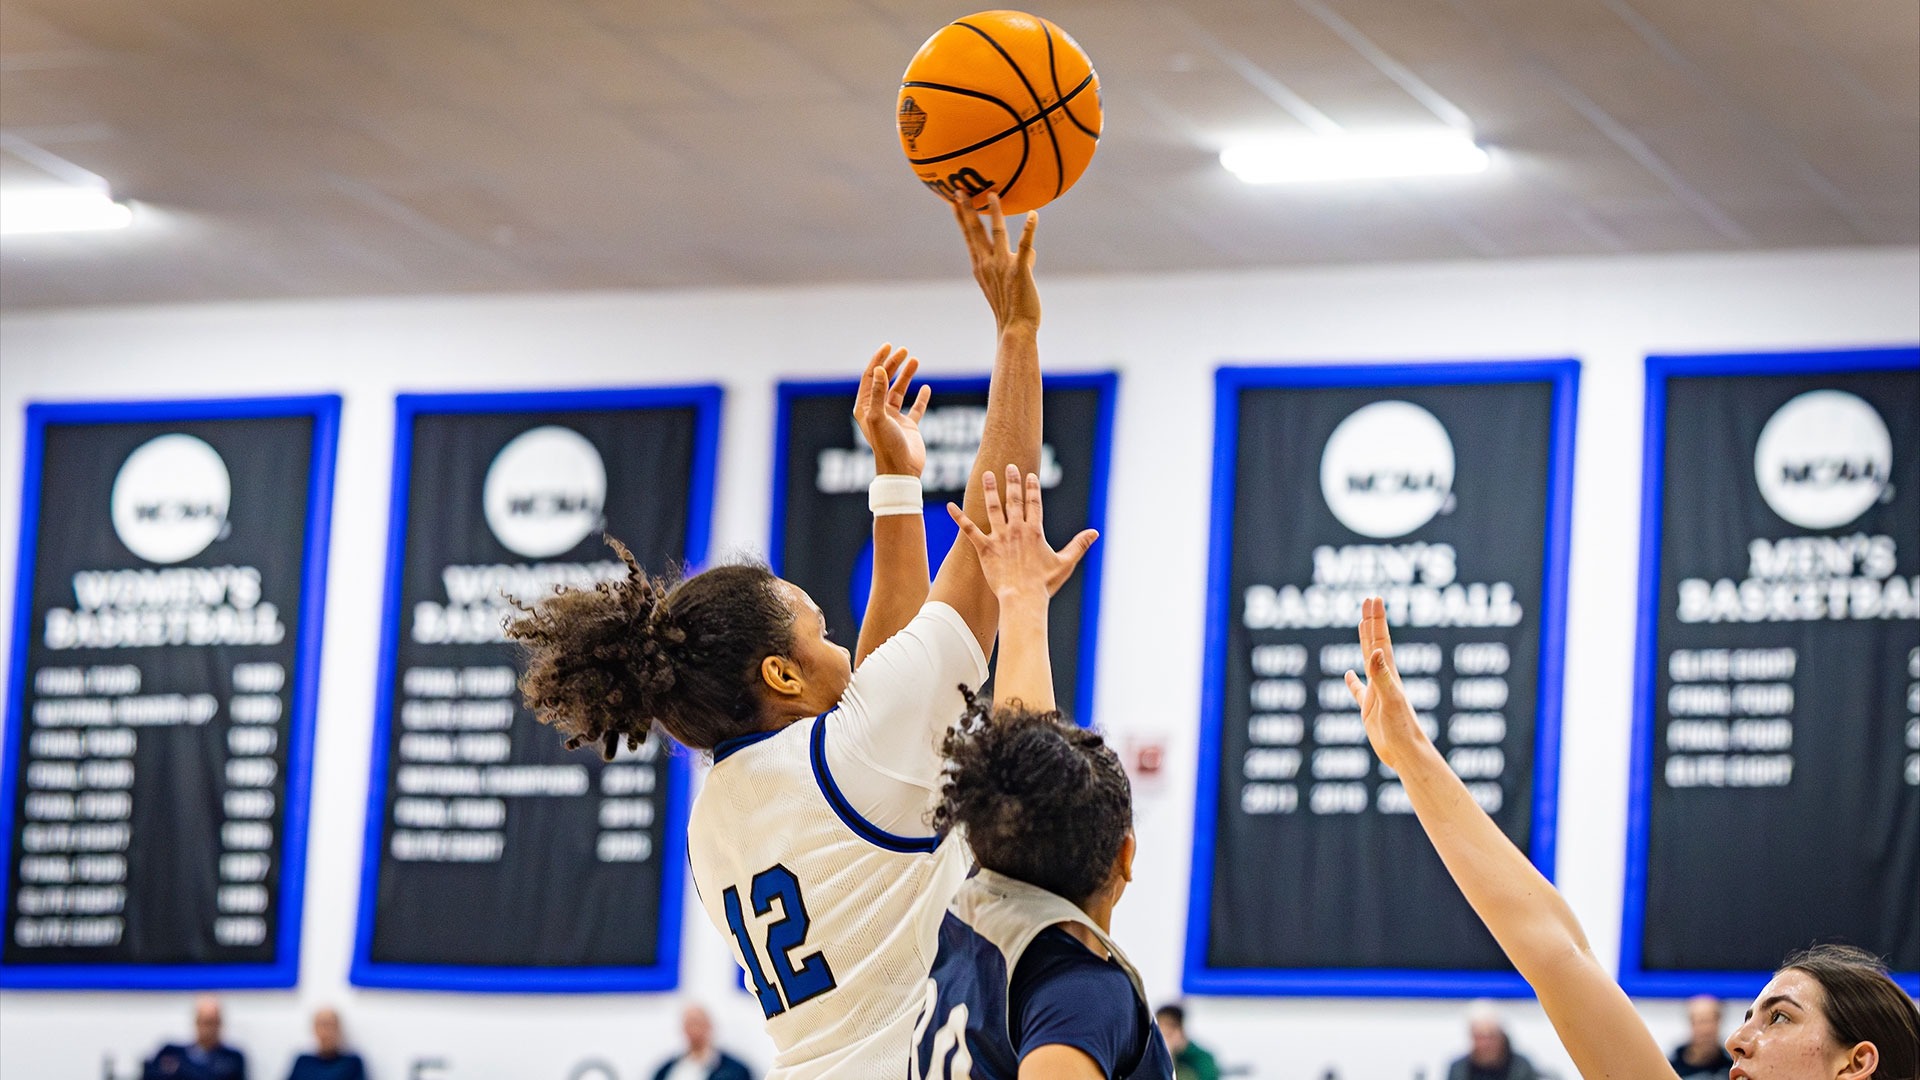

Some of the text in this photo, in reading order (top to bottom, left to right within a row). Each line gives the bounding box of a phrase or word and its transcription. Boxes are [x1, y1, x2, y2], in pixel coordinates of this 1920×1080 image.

[1313, 543, 1456, 586] MEN'S
[1749, 535, 1897, 579] MEN'S
[74, 567, 261, 609] WOMEN'S
[46, 604, 285, 648] BASKETBALL
[1668, 684, 1794, 715] FINAL FOUR
[1667, 719, 1792, 750] FINAL FOUR
[722, 863, 837, 1020] 12
